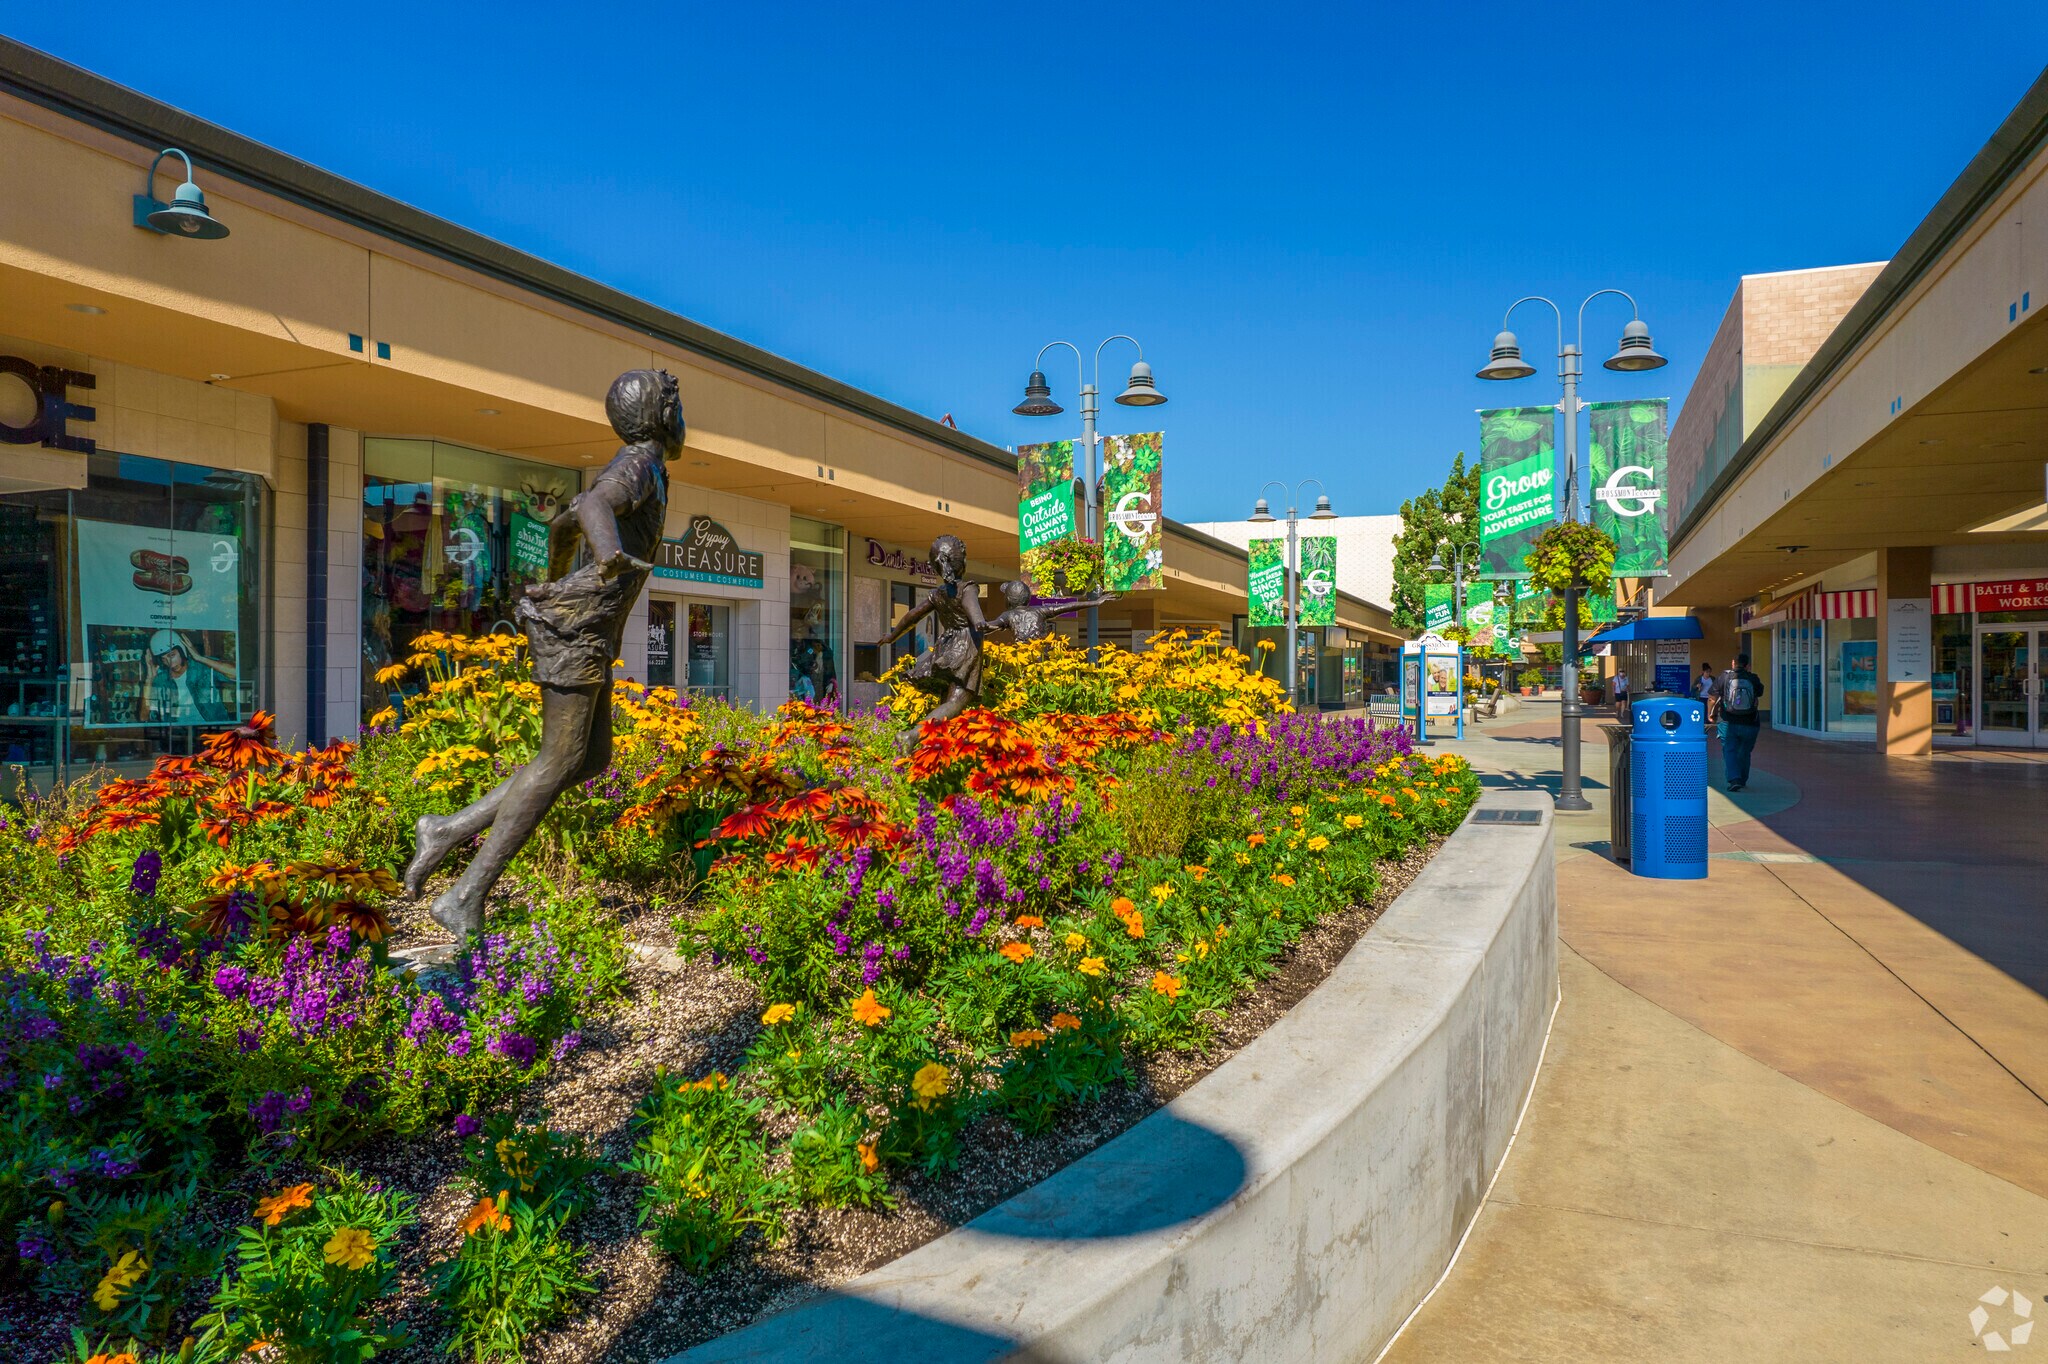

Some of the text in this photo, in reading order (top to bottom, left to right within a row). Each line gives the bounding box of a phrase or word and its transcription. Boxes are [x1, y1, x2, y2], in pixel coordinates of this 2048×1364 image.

[1486, 468, 1553, 510] Grow
[1030, 492, 1053, 508] BEING
[1482, 493, 1552, 523] YOUR TASTE FOR
[1022, 498, 1066, 528] Outside
[1484, 504, 1554, 536] ADVENTURE
[694, 520, 730, 550] Gypsy
[1024, 512, 1068, 538] IS ALWAYS
[1031, 524, 1067, 546] IN STYLE
[663, 543, 757, 576] TREASURE
[662, 568, 704, 581] COSTUMES
[717, 576, 758, 587] COSMETICS
[1251, 577, 1283, 596] SINCE
[1257, 576, 1266, 585] LA
[1265, 570, 1283, 581] MESA
[1260, 588, 1280, 602] 1961
[1976, 585, 2014, 596] BATH
[2019, 583, 2030, 593] &
[1426, 603, 1449, 615] WHERE
[1435, 608, 1451, 619] FUN
